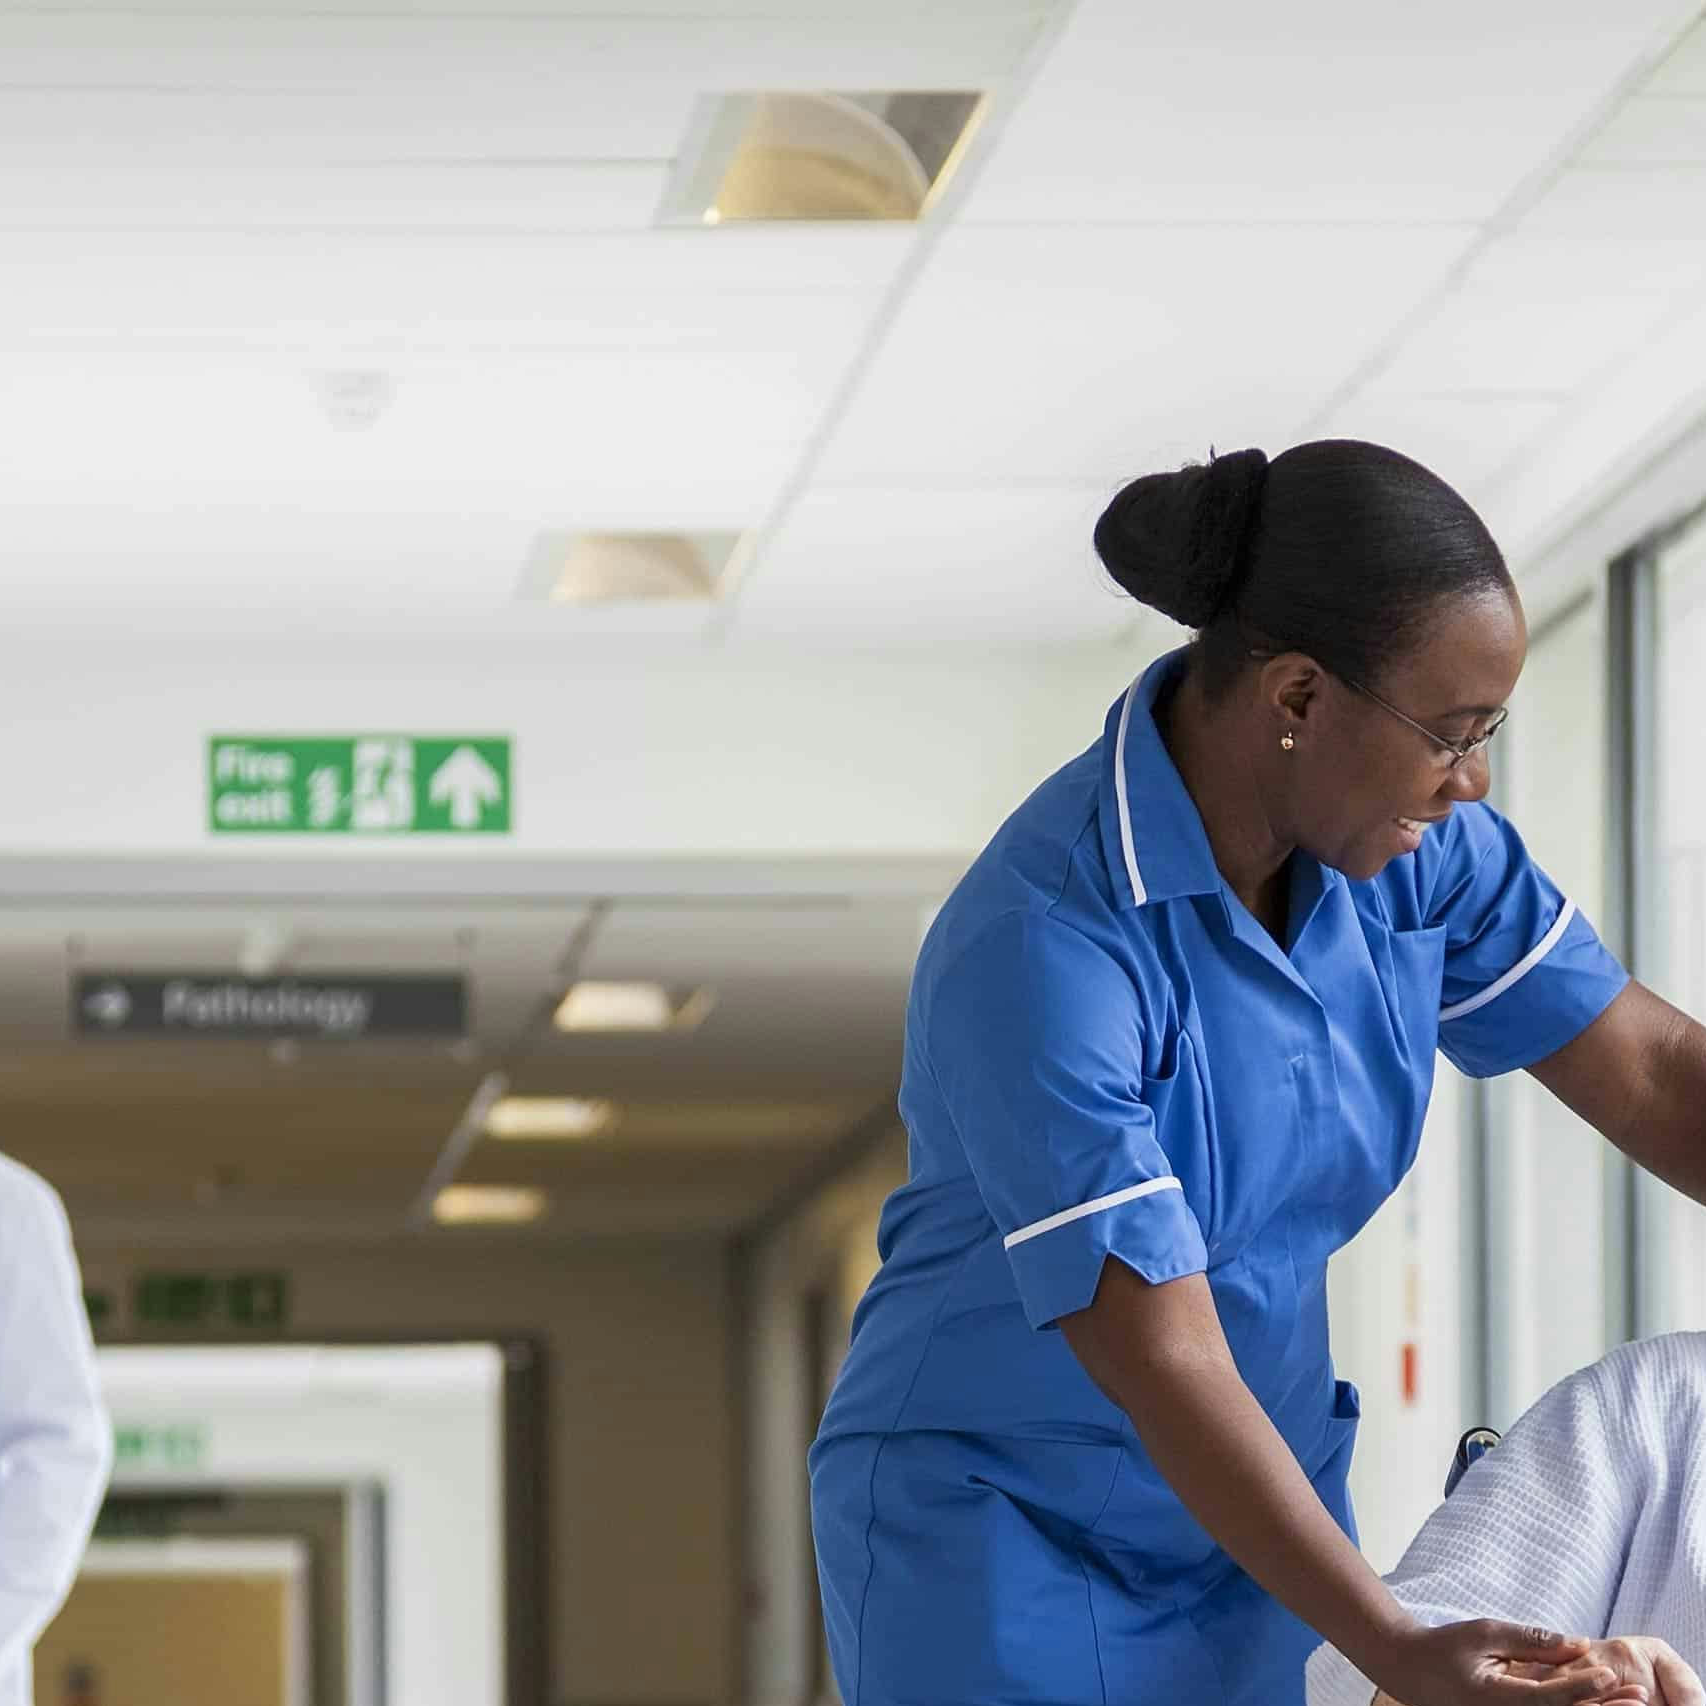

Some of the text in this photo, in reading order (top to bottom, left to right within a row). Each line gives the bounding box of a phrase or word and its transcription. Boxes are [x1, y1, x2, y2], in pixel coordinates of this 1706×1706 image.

[215, 747, 292, 782] Fire
[215, 790, 291, 823] exit
[162, 981, 367, 1030] Pathology
